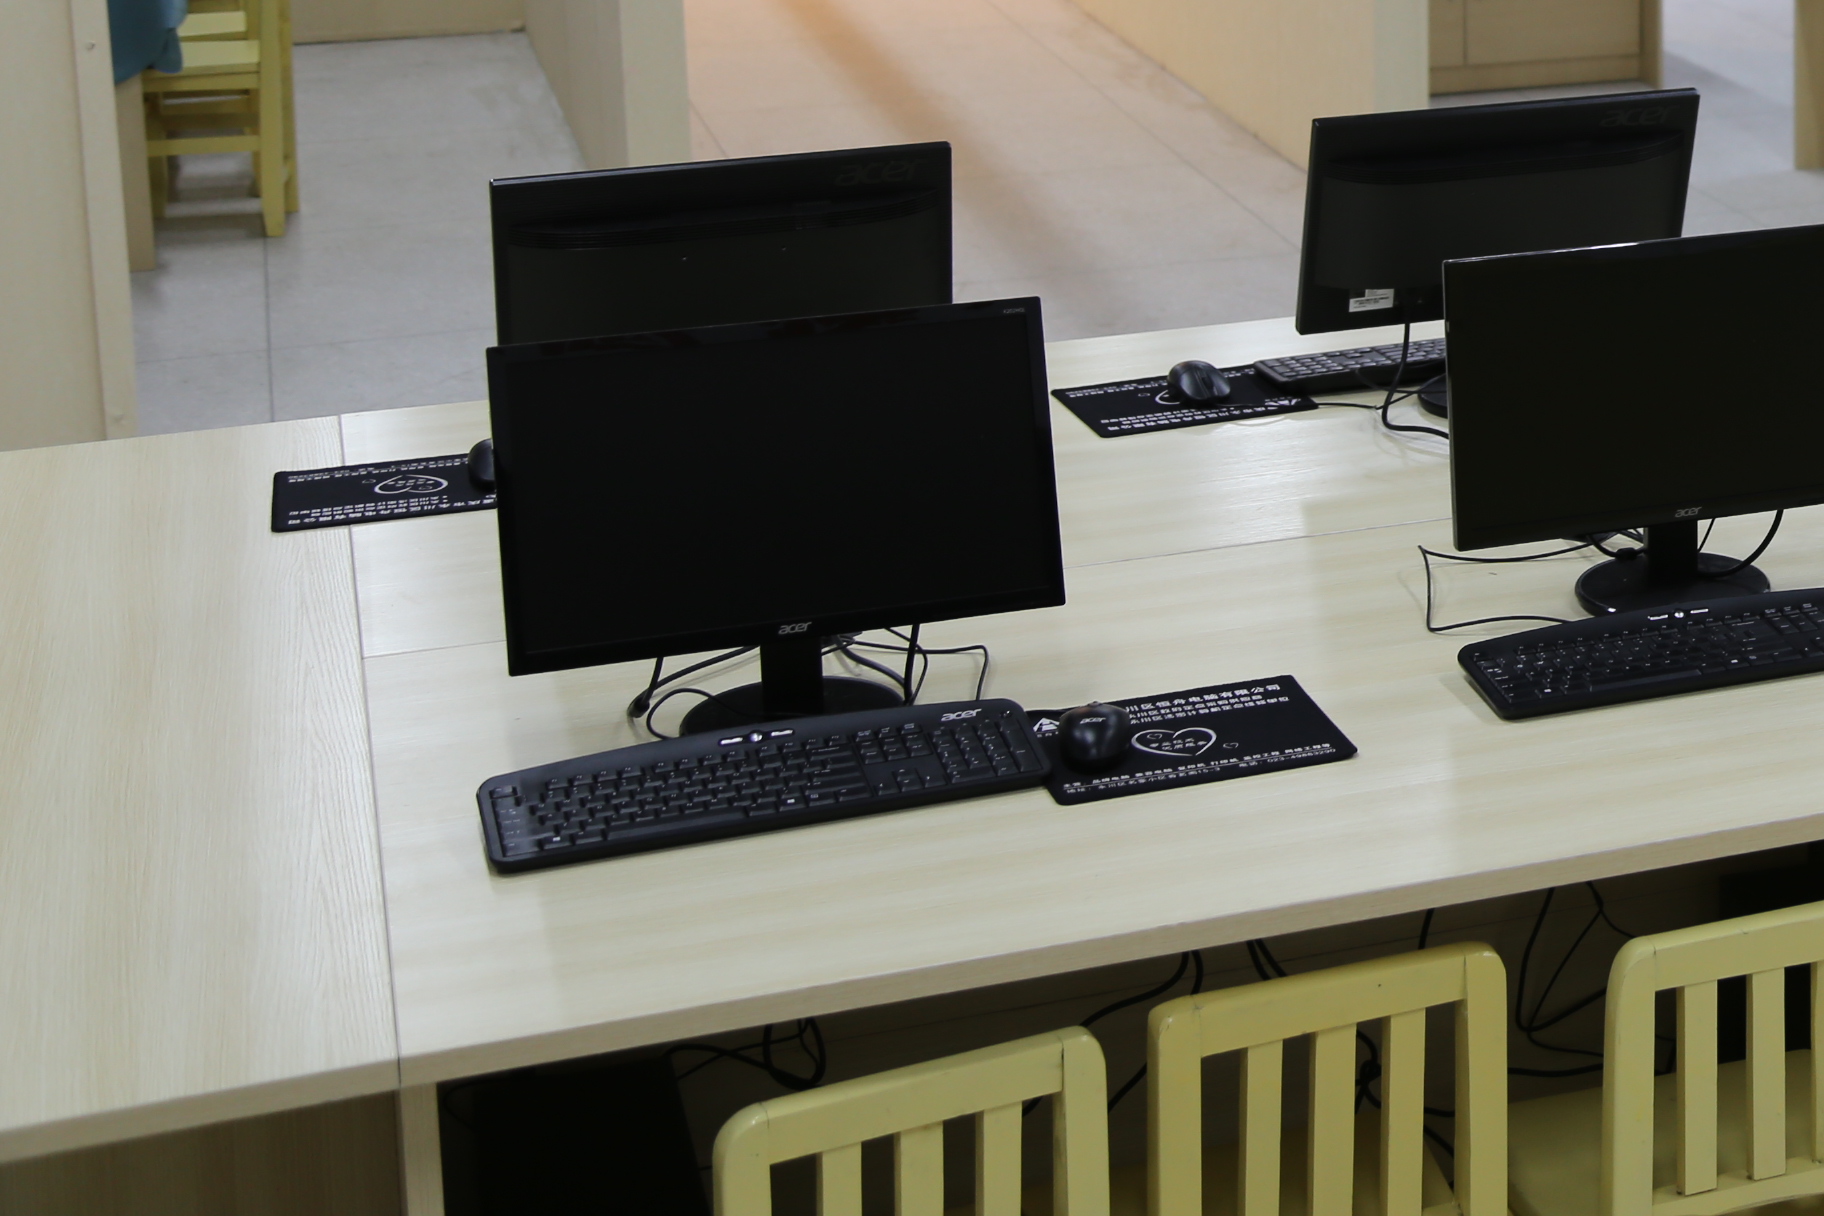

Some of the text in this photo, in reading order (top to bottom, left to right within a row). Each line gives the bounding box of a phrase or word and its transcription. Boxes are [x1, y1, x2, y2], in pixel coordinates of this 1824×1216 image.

[1600, 105, 1680, 127] acer
[834, 160, 921, 186] acer
[1674, 506, 1702, 518] acer
[778, 622, 812, 634] acer
[941, 708, 982, 721] acer
[1080, 716, 1106, 724] acer
